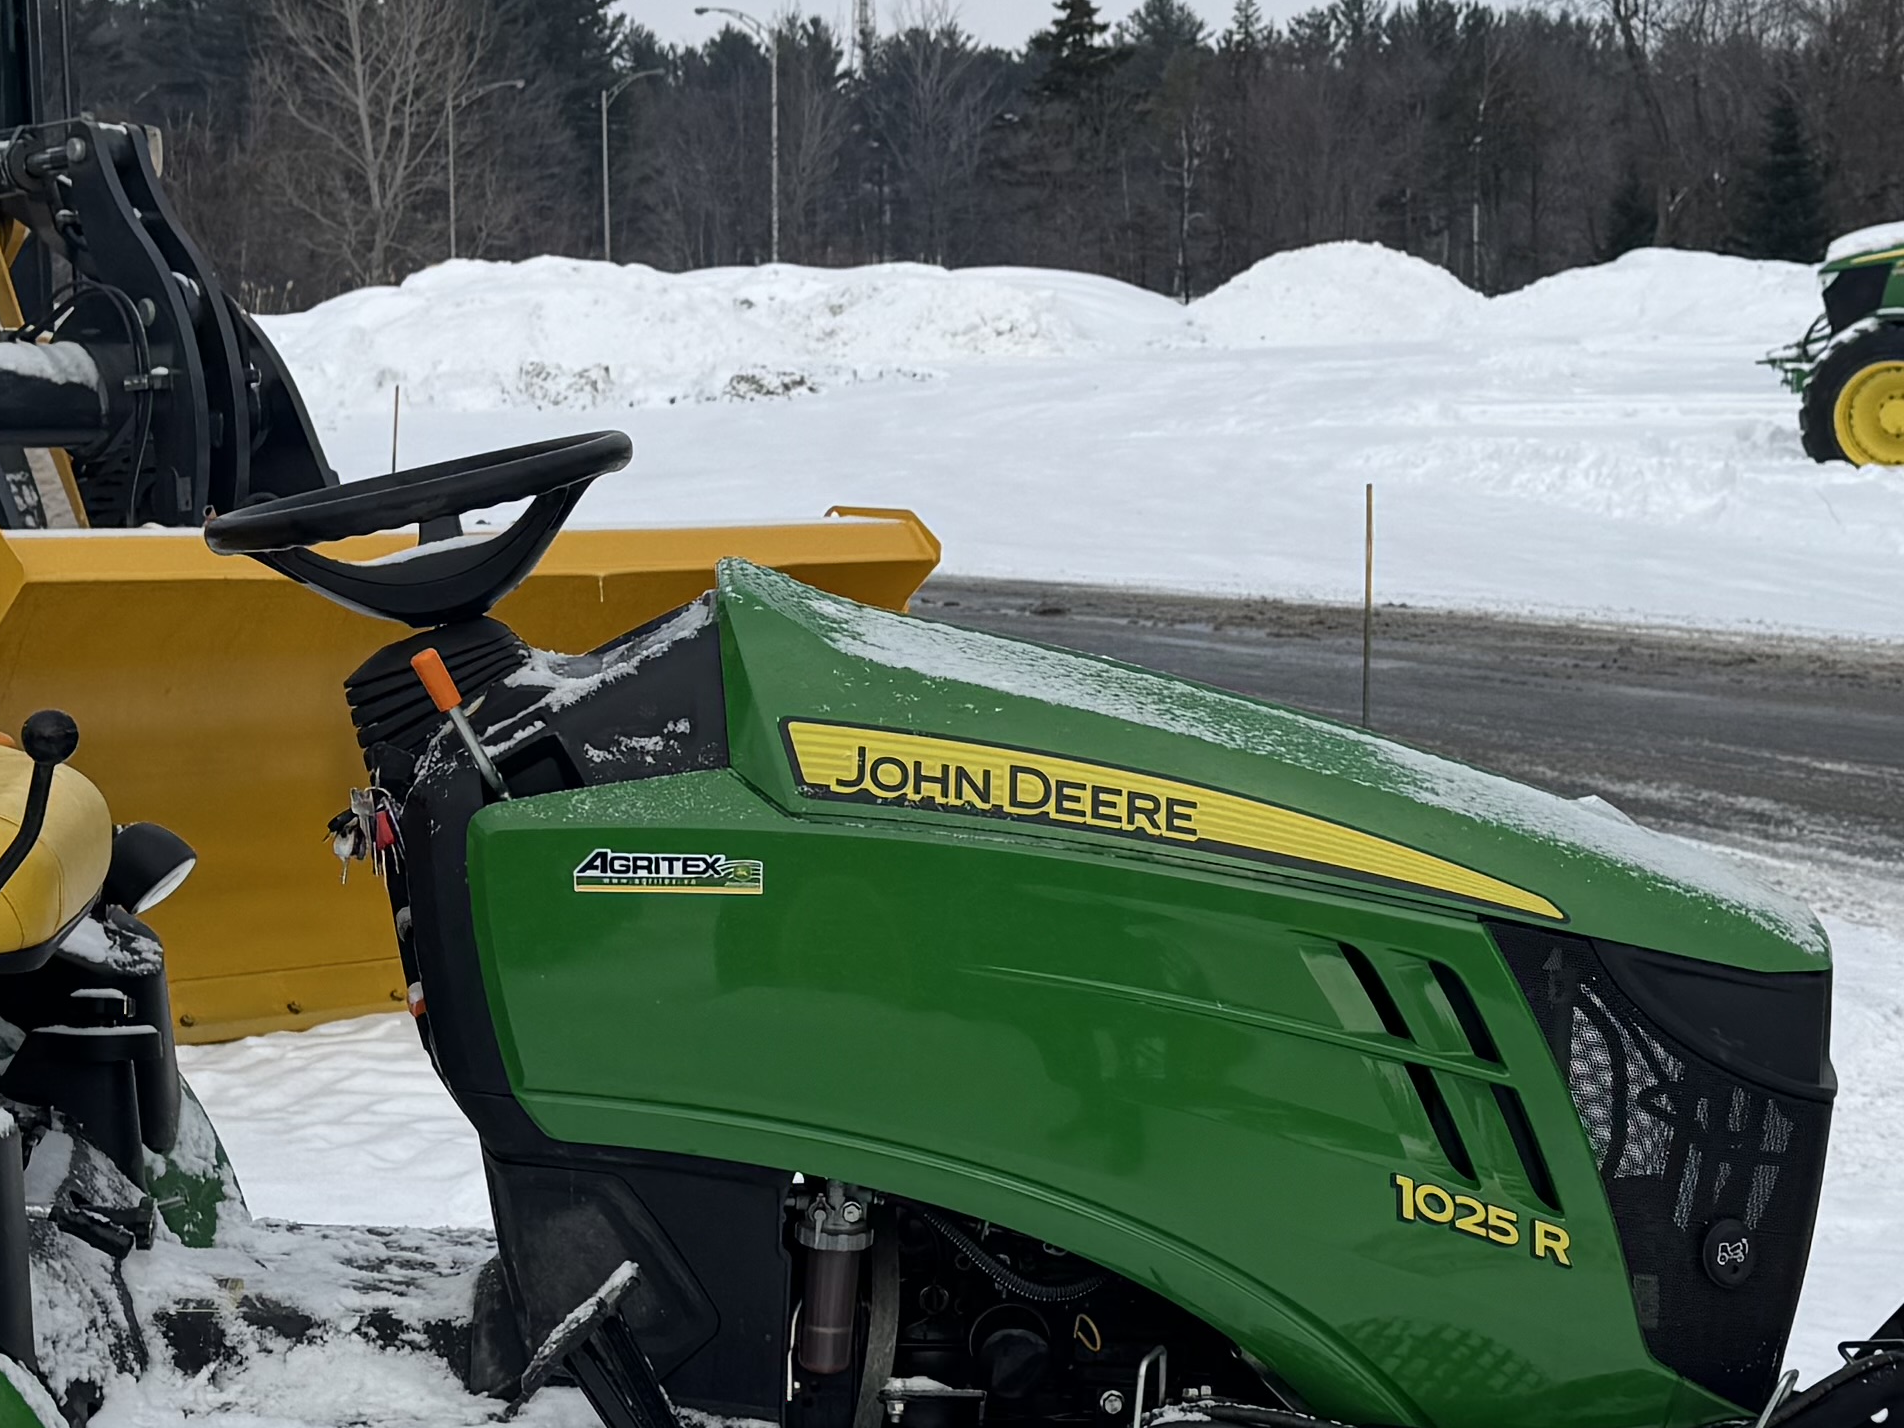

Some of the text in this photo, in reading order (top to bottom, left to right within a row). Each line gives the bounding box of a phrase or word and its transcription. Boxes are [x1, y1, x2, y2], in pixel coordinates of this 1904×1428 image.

[835, 746, 1199, 837] JOHN DEERE
[576, 851, 724, 876] AGRITEX
[1393, 1174, 1572, 1267] 1025 R
